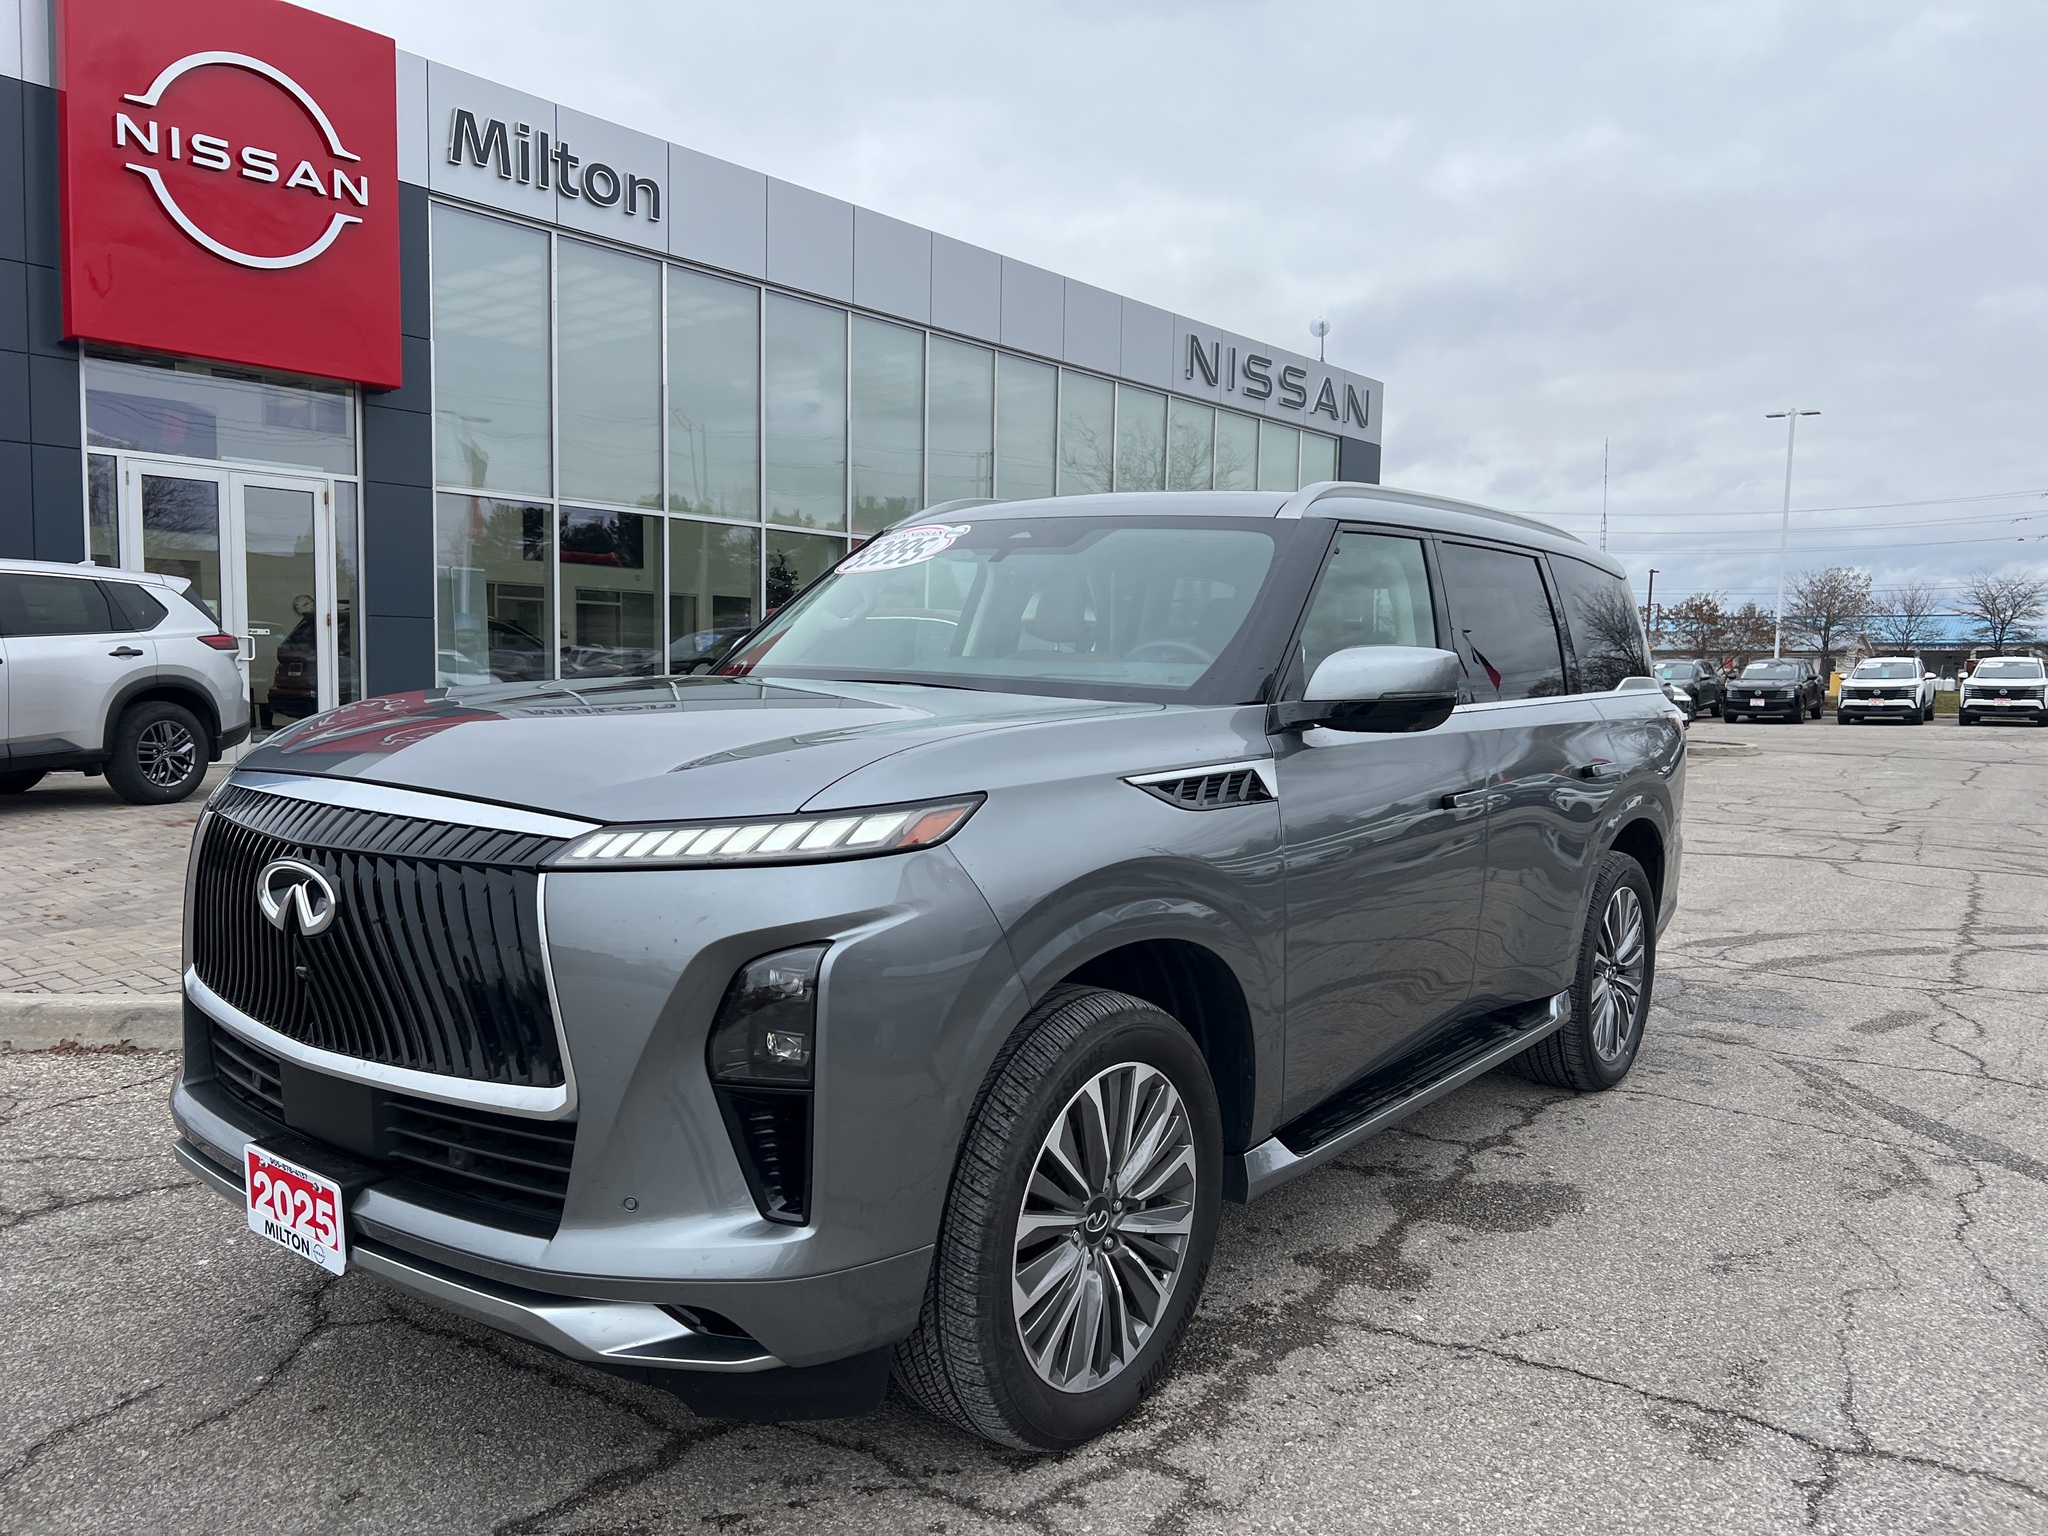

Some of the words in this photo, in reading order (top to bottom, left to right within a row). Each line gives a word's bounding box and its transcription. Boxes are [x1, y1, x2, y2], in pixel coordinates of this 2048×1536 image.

[114, 112, 369, 207] NISSAN
[447, 107, 662, 223] Milton
[1185, 333, 1371, 429] NISSAN
[253, 1170, 337, 1247] 2025
[264, 1219, 310, 1256] MILTON
[1136, 1258, 1209, 1400] BRIDGESTONE
